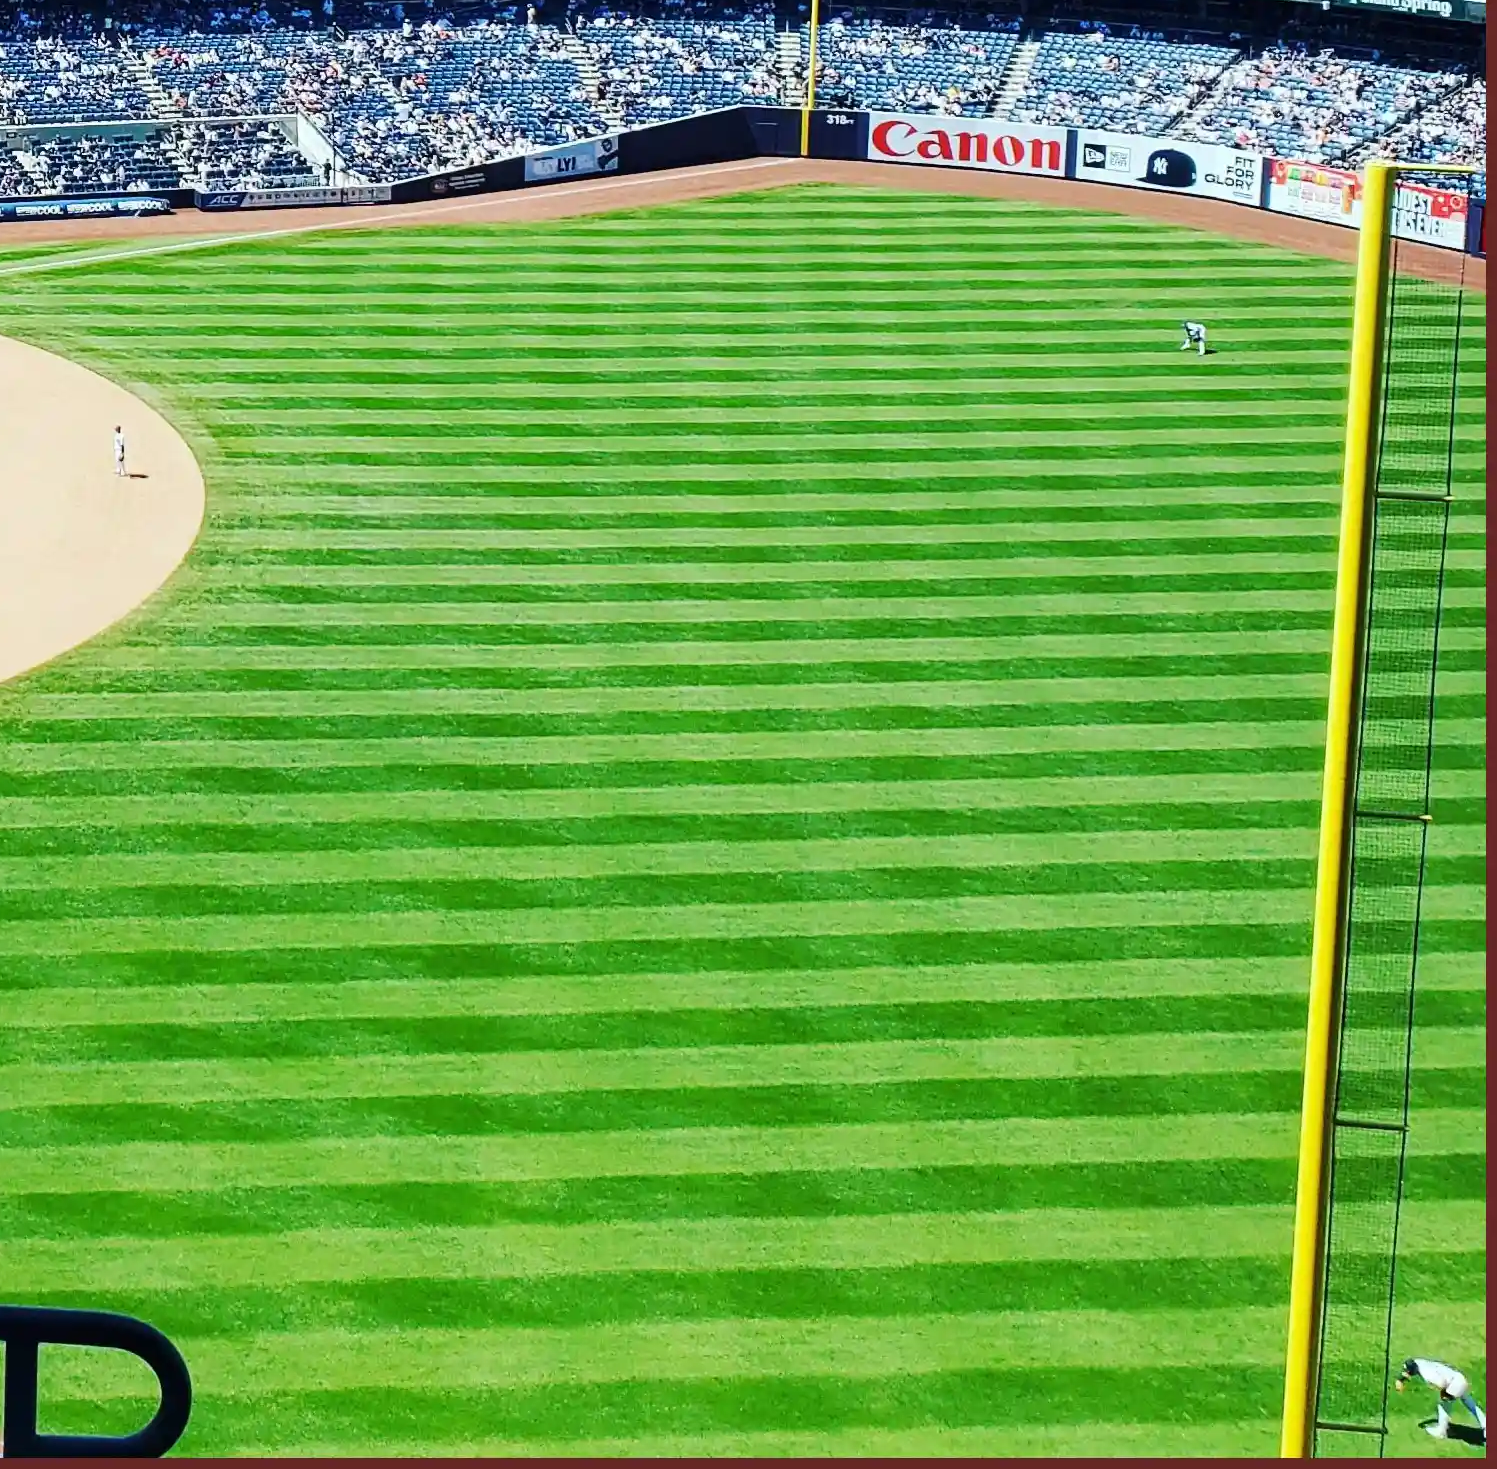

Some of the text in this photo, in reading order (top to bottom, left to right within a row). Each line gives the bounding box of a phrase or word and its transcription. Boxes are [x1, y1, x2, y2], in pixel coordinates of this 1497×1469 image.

[826, 114, 847, 125] 318
[872, 120, 1061, 171] Canon
[1235, 156, 1256, 169] FIT
[1227, 166, 1255, 180] FOR
[1204, 173, 1254, 191] GLORY
[210, 195, 239, 205] ACC
[37, 205, 64, 215] COOL
[90, 202, 114, 212] COOL
